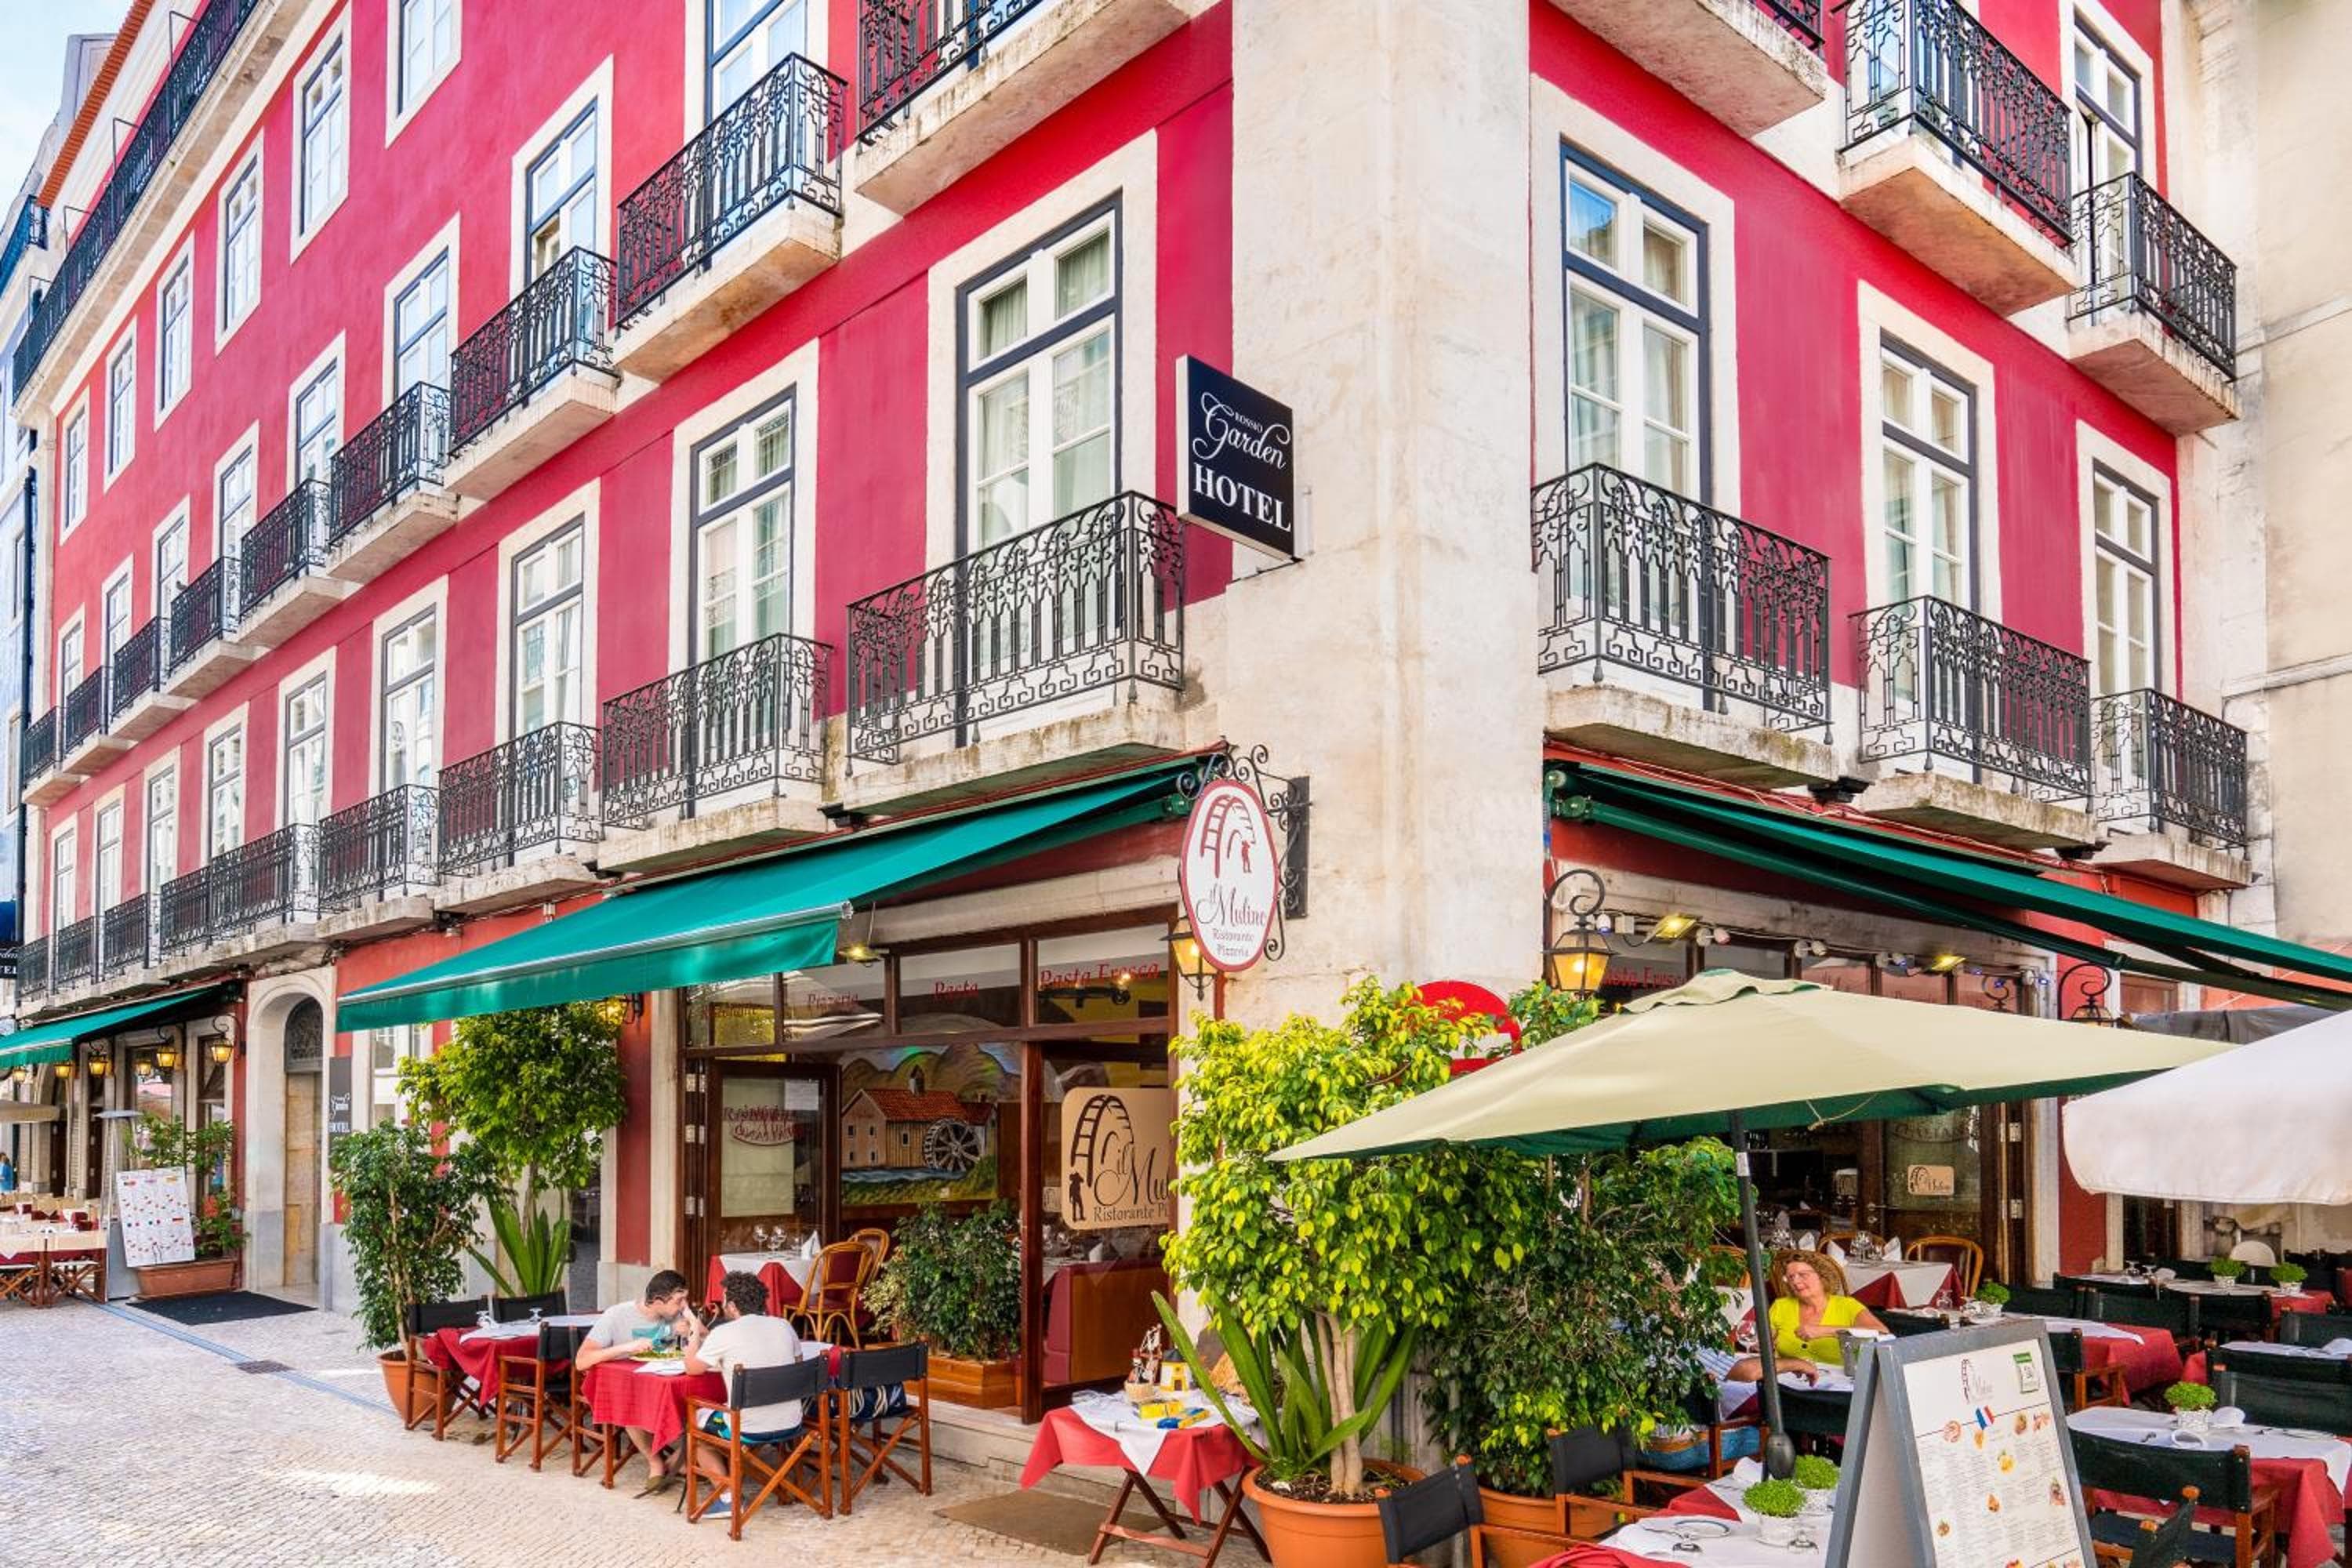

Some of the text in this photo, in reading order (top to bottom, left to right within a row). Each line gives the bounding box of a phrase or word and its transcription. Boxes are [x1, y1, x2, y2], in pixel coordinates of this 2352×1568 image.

[1192, 392, 1291, 470] Garden
[1193, 462, 1291, 532] HOTEL
[1211, 927, 1254, 943] Ristorante
[1040, 961, 1160, 985] Pasta Fresca
[934, 979, 978, 1000] Pasta
[1094, 1206, 1155, 1222] Ristorante
